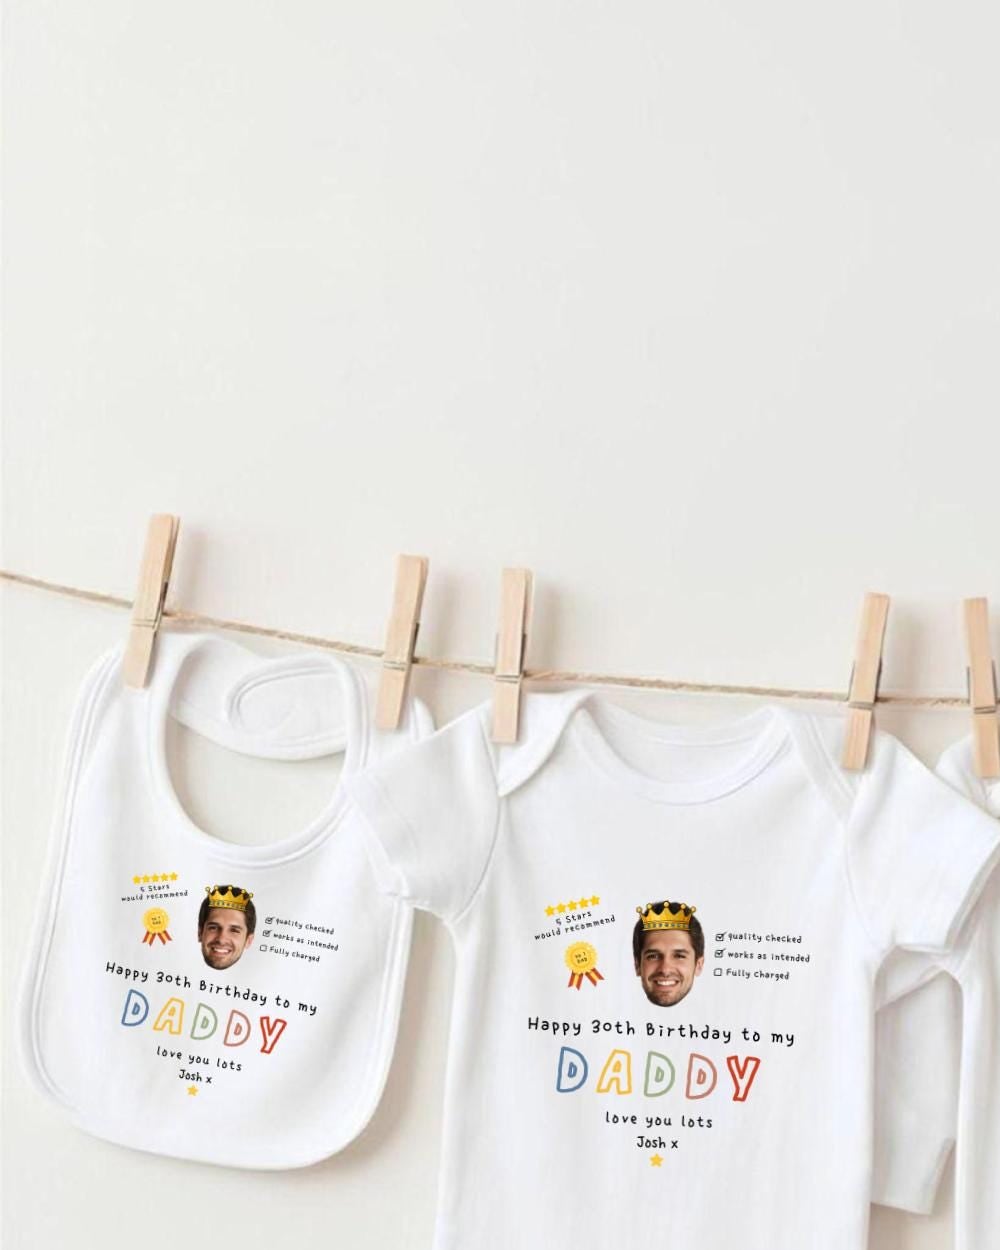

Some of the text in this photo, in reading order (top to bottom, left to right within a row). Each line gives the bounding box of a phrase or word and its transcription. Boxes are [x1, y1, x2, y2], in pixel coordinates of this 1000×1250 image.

[146, 890, 188, 900] recommend
[148, 884, 170, 892] Stars
[555, 910, 592, 926] 5 Stars
[276, 918, 335, 935] quality checked
[534, 916, 616, 940] would recommend
[273, 933, 294, 942] works
[307, 939, 339, 951] intended
[728, 932, 802, 944] quality checked
[292, 951, 320, 963] charged
[728, 950, 810, 963] works as intended
[754, 970, 790, 981] charged
[106, 962, 317, 1016] Happy 30th Birthday to my
[121, 988, 287, 1054] DADDY
[528, 1016, 795, 1046] Happy 30th Birthday to my
[156, 1046, 243, 1071] love you lots
[179, 1070, 212, 1084] Josh x
[556, 1046, 761, 1102] DADDY
[605, 1111, 713, 1129] love you lots
[636, 1135, 679, 1150] Josh x
